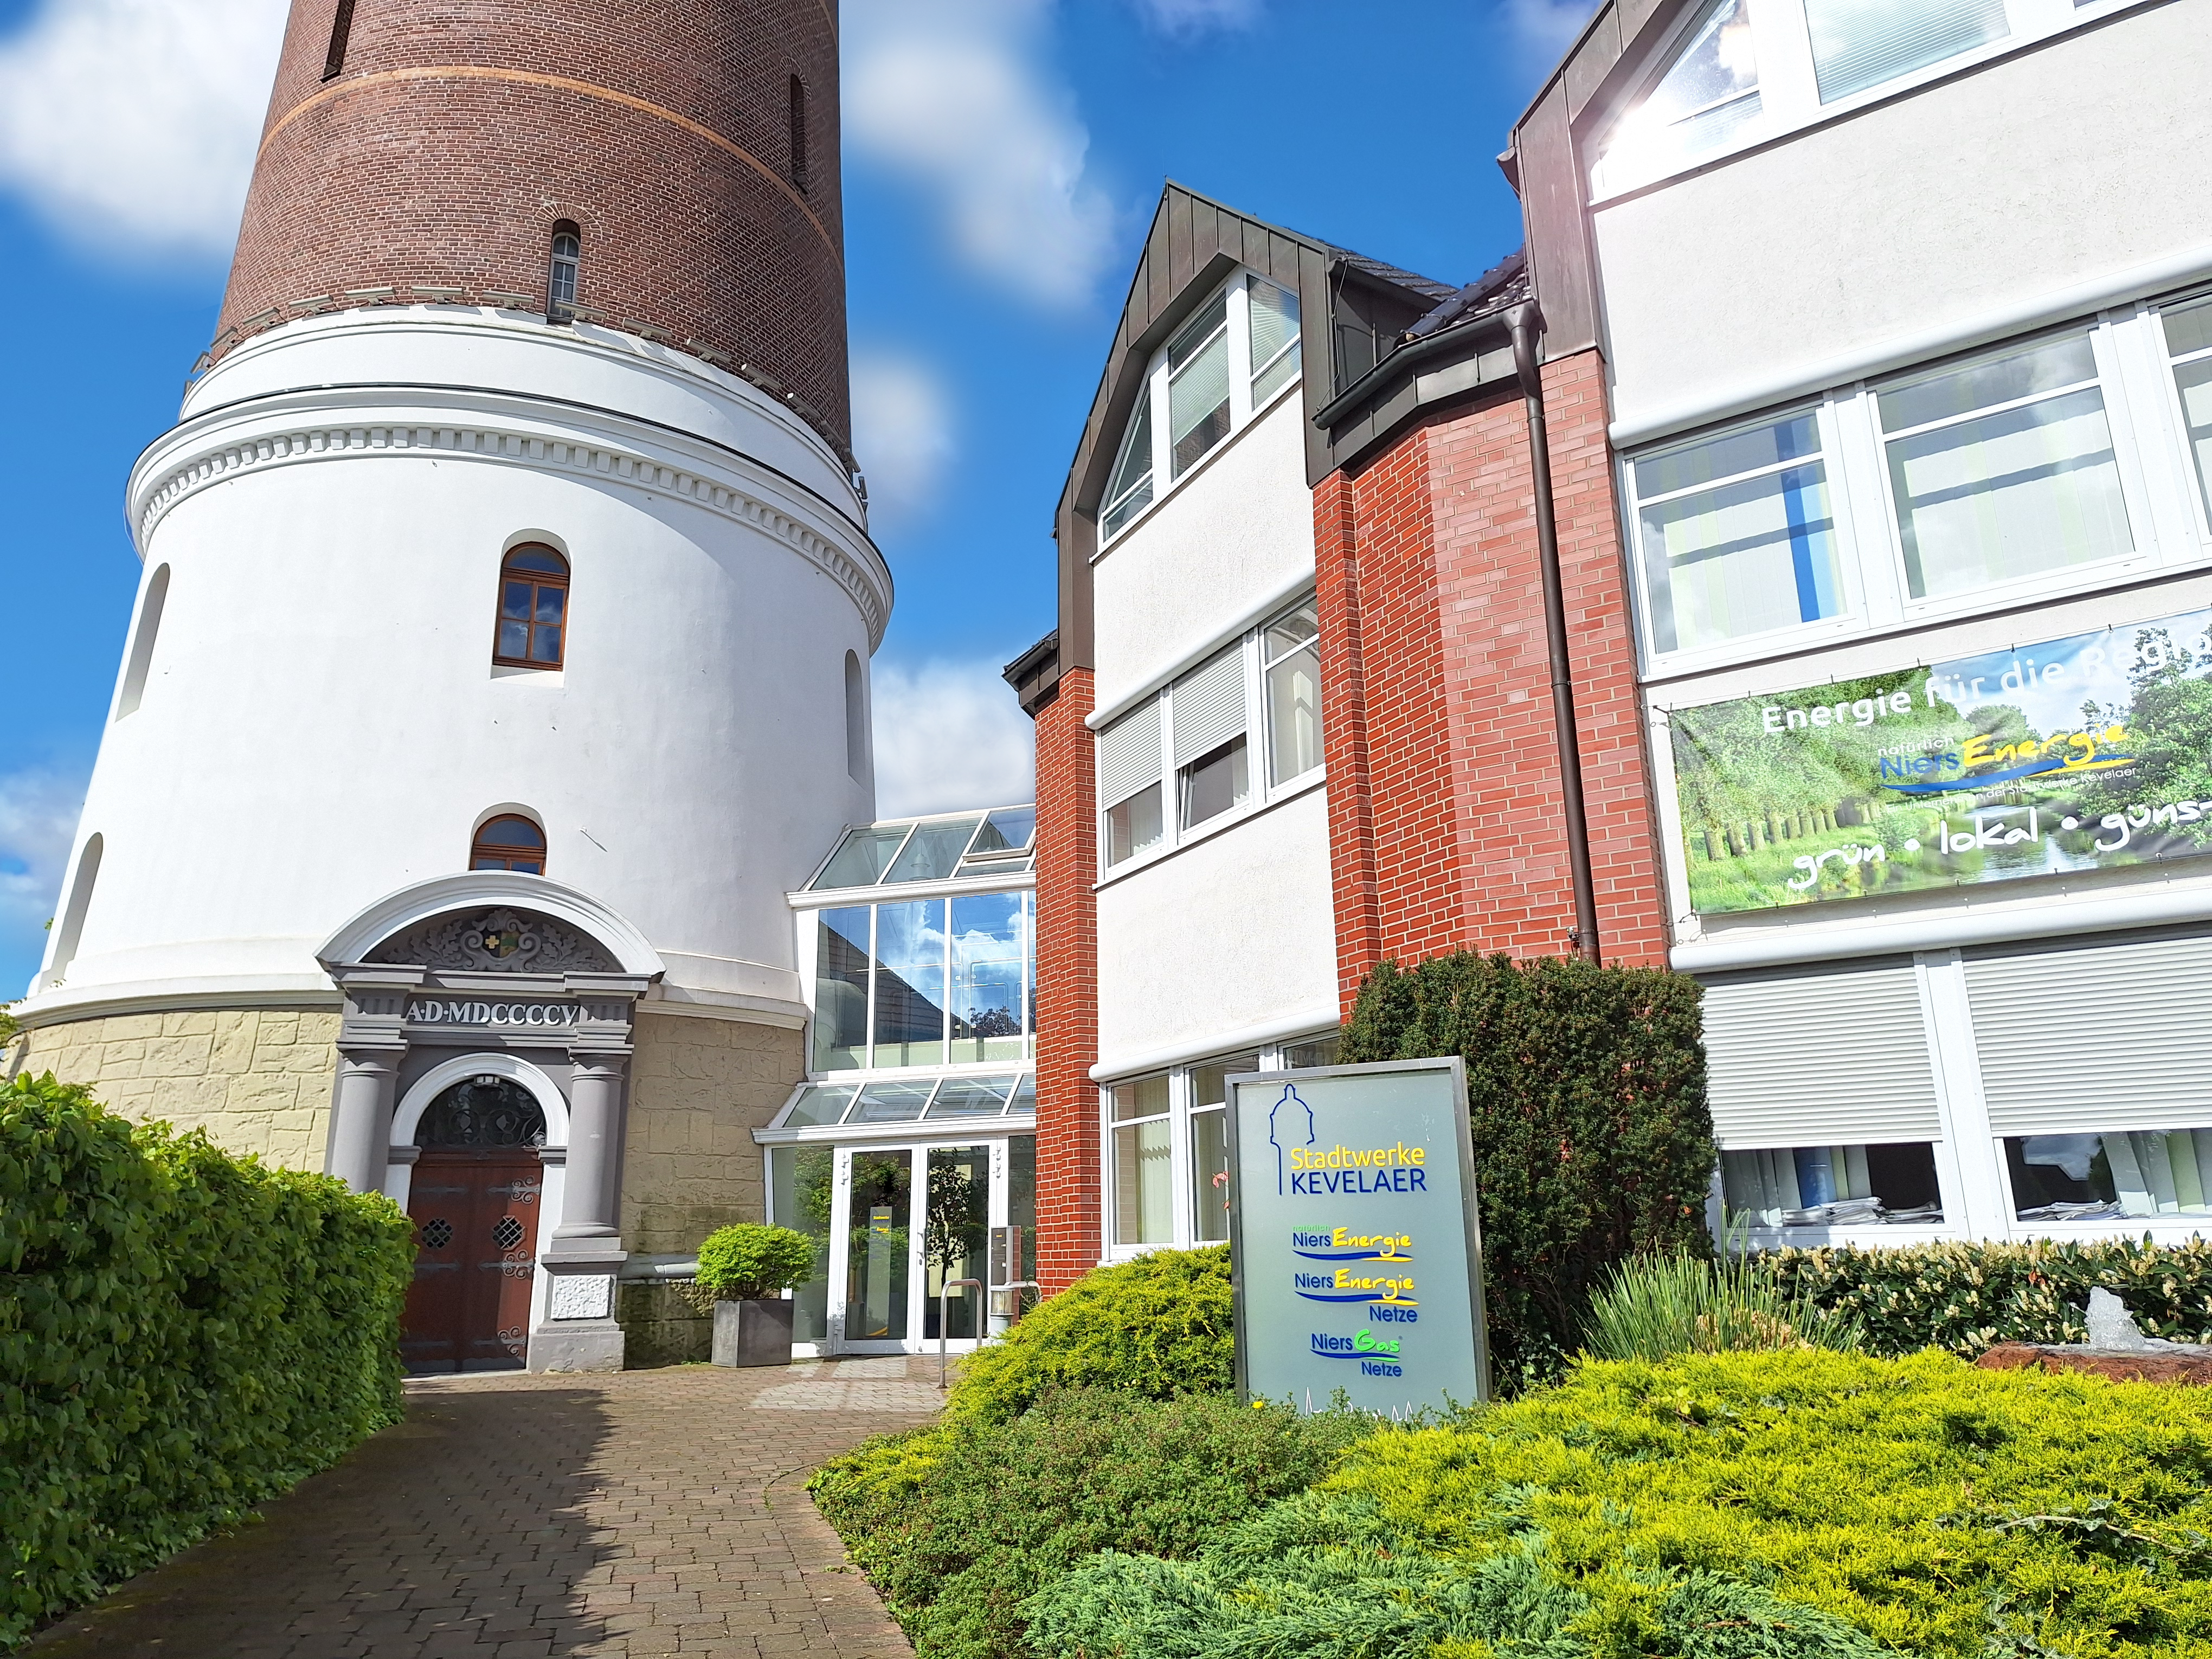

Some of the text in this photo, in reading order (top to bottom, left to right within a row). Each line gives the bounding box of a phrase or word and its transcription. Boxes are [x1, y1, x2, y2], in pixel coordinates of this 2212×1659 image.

[1761, 688, 1912, 734] Energie
[1925, 673, 1985, 708] für
[2001, 658, 2066, 692] die
[1877, 736, 1955, 756] natürlich
[1886, 803, 1902, 814] Ein
[1986, 788, 2007, 799] der
[2008, 777, 2078, 795] Stadtwerke
[2081, 768, 2138, 783] Kevelaer
[1787, 800, 2212, 890] grün lokal güns
[1290, 1141, 1425, 1170] Stadtwerke
[1291, 1168, 1427, 1194] KEVELAER
[1292, 1224, 1330, 1232] natürlich
[1369, 1305, 1418, 1323] Netze
[1361, 1361, 1403, 1377] Netze
